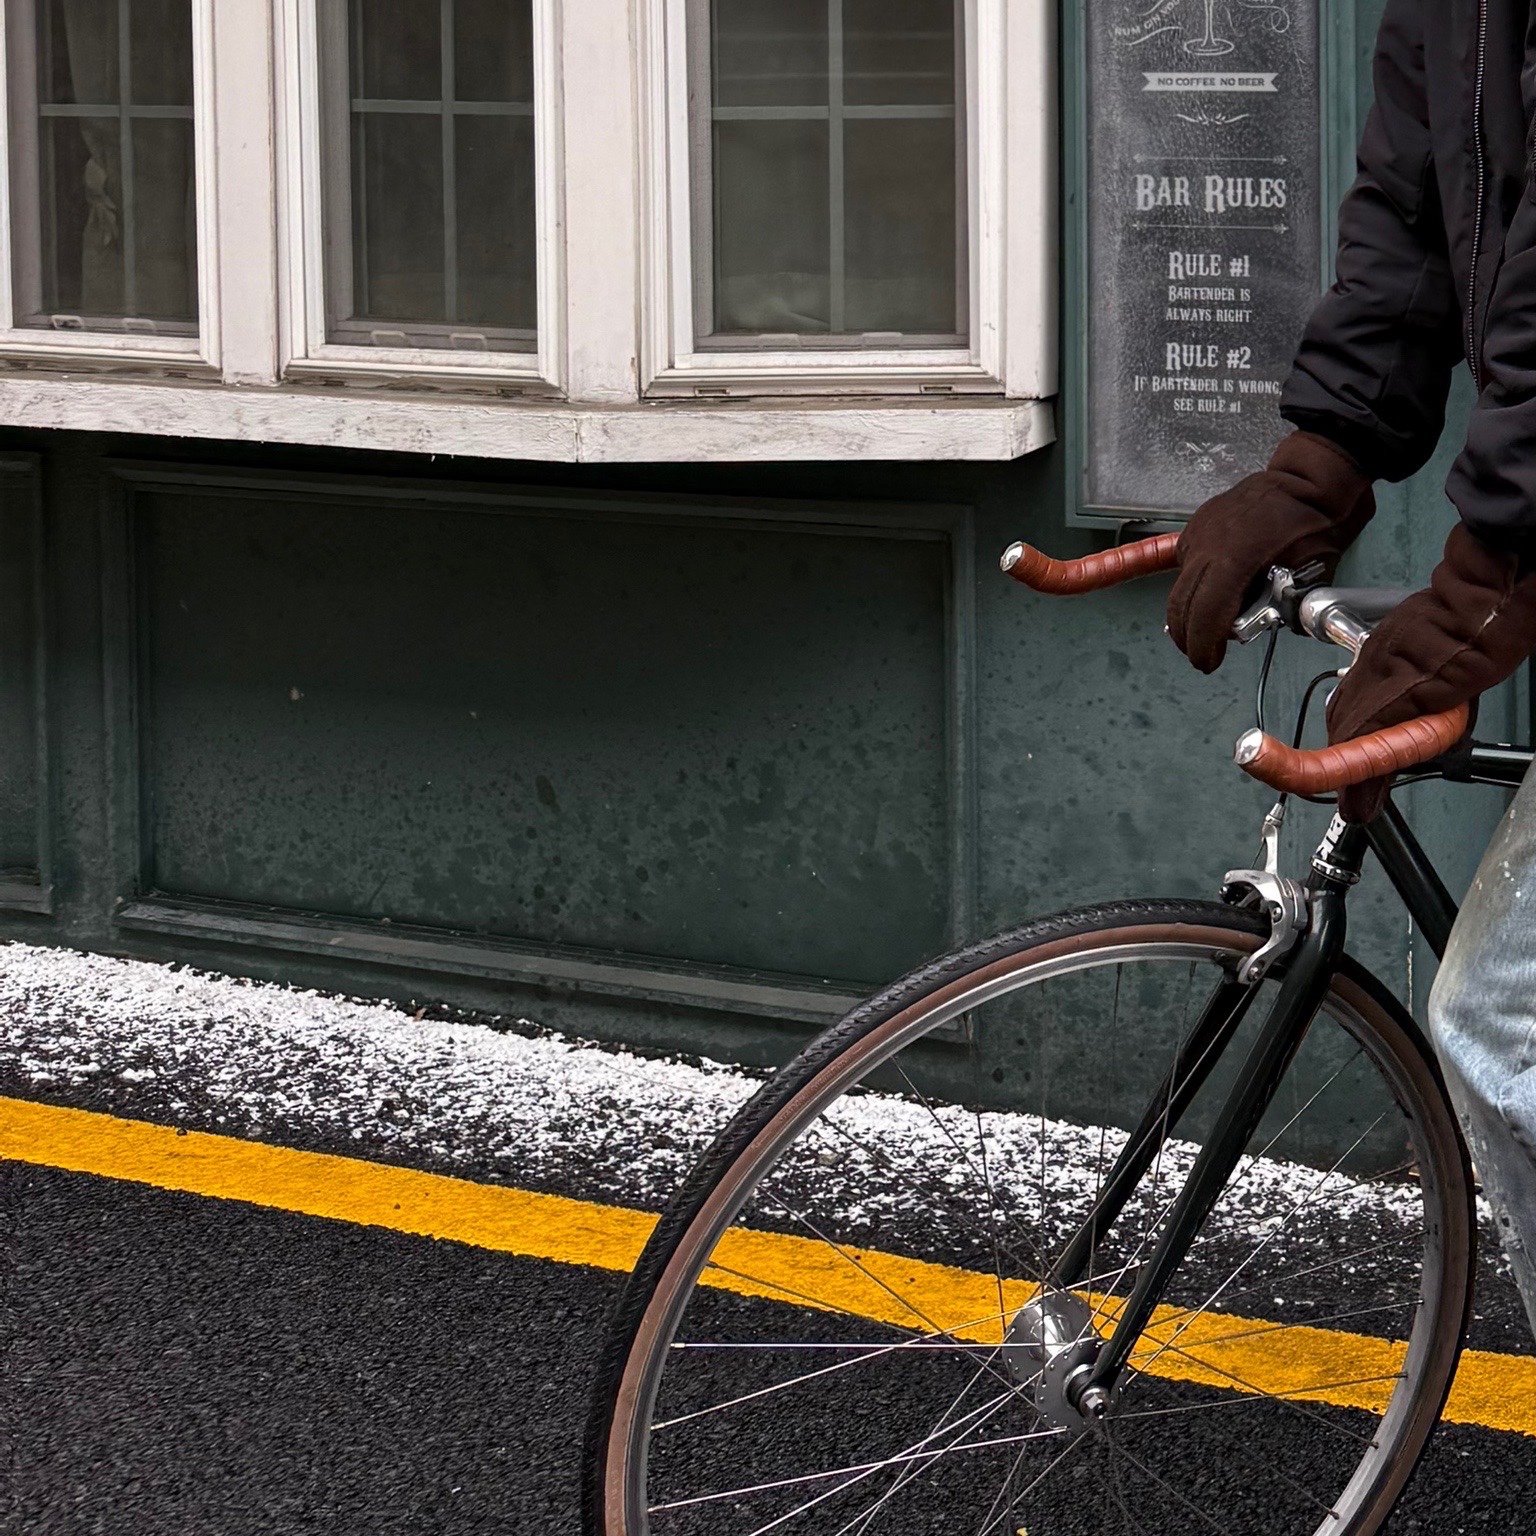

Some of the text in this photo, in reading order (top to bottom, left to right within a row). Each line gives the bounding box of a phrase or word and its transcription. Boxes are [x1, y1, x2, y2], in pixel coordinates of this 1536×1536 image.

[1114, 25, 1141, 37] RUM
[1144, 13, 1161, 30] GIN
[1158, 78, 1265, 87] NO COFFEE NO BEER
[1135, 174, 1286, 213] BAR RULES
[1168, 251, 1250, 280] RULE #1
[1168, 285, 1251, 302] BARTENDER IS
[1166, 308, 1252, 322] ALWAYS RIGHT
[1165, 342, 1251, 370] RULE #2
[1134, 375, 1147, 391] IF
[1152, 376, 1218, 392] BARTENDER
[1223, 379, 1234, 393] IS
[1173, 398, 1241, 413] SEE RULE #1
